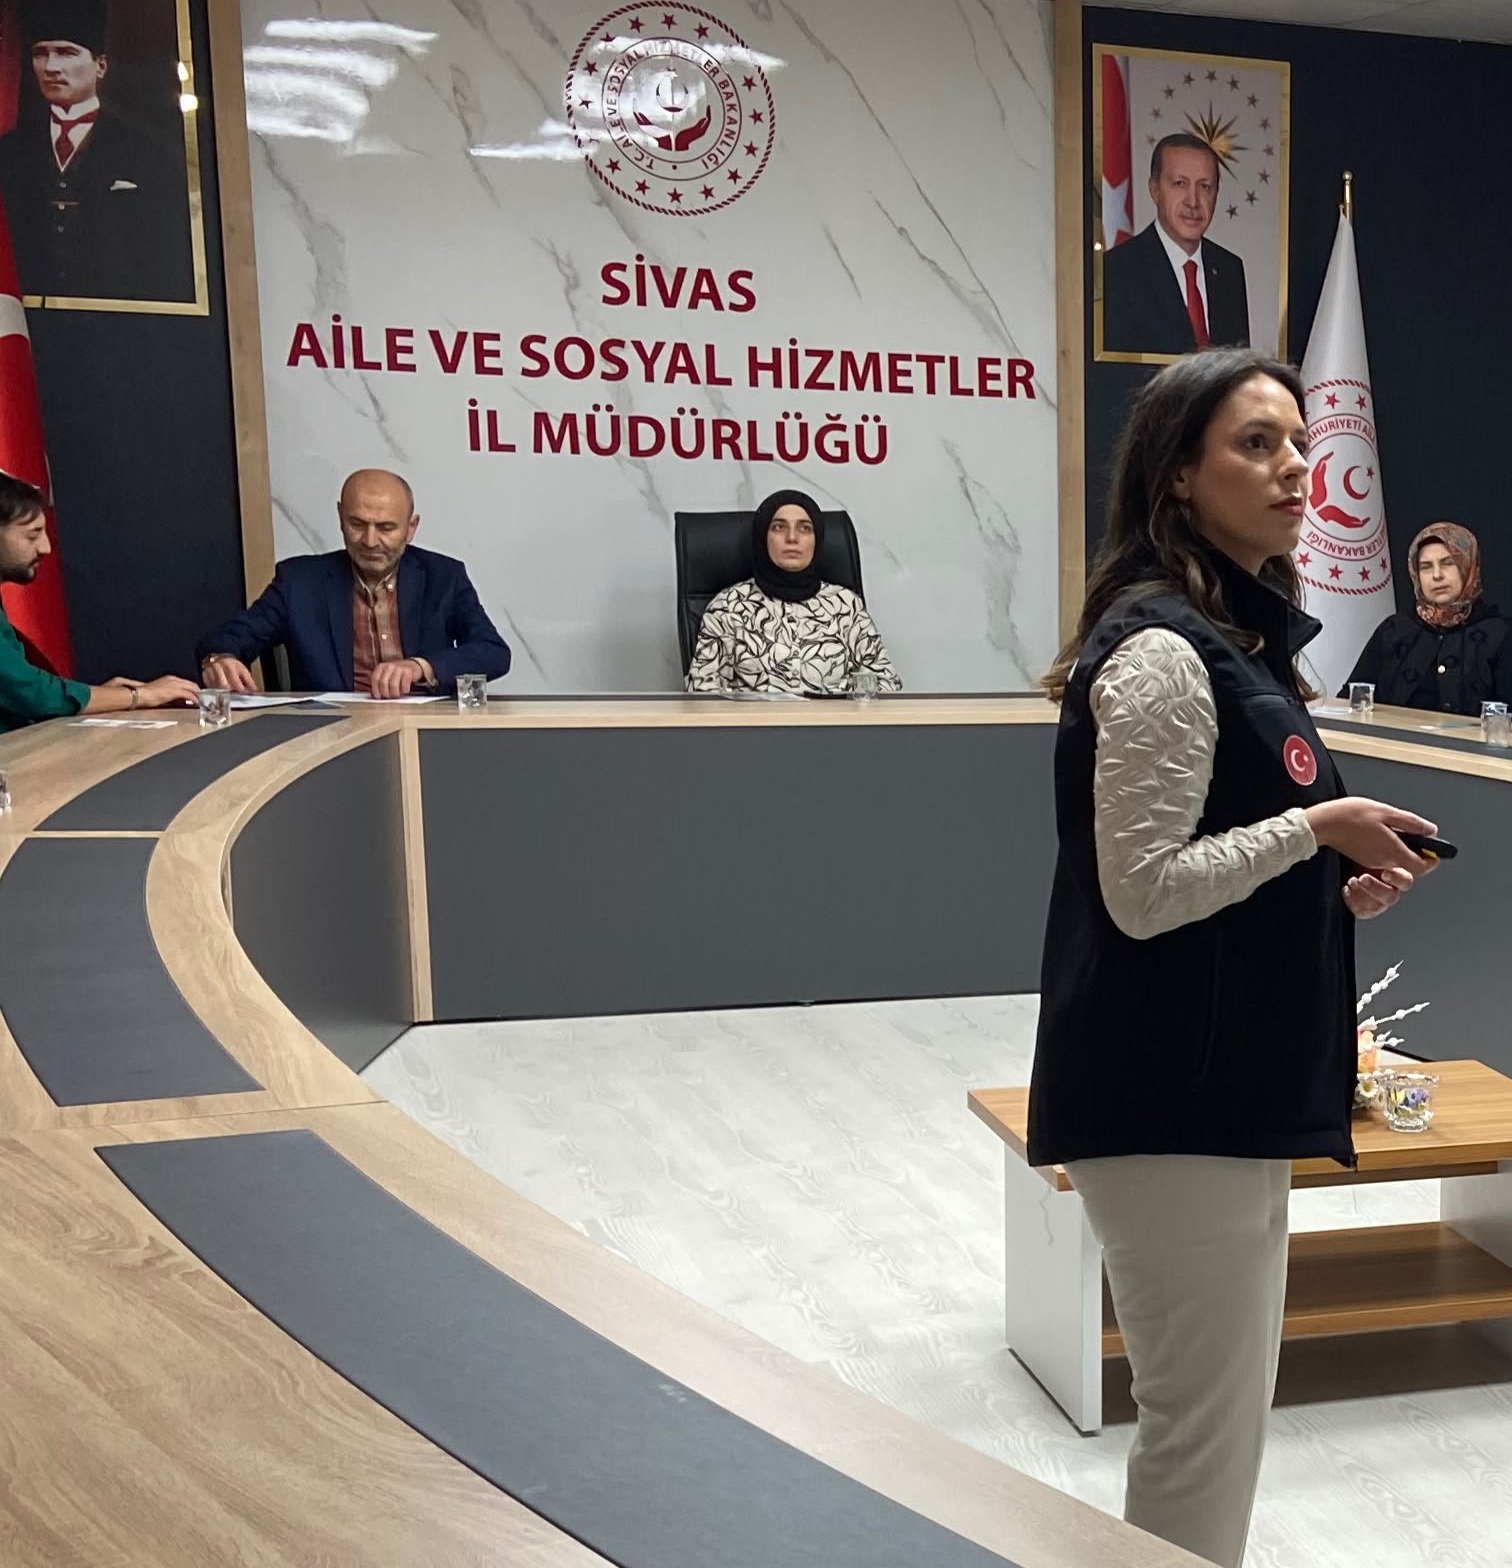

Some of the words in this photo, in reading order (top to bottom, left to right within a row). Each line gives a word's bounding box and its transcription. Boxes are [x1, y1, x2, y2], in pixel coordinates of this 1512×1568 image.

[608, 50, 644, 93] SOSYAL
[606, 97, 617, 116] VE
[701, 79, 738, 170] BAKANLIĞI
[601, 254, 757, 312] SİVAS
[287, 314, 416, 372] AİLE
[428, 331, 503, 376] VE
[520, 335, 732, 386] SOSYAL
[747, 338, 1036, 399] HİZMETLER
[467, 398, 516, 452] İL
[532, 403, 888, 465] MÜDÜRLÜĞÜ
